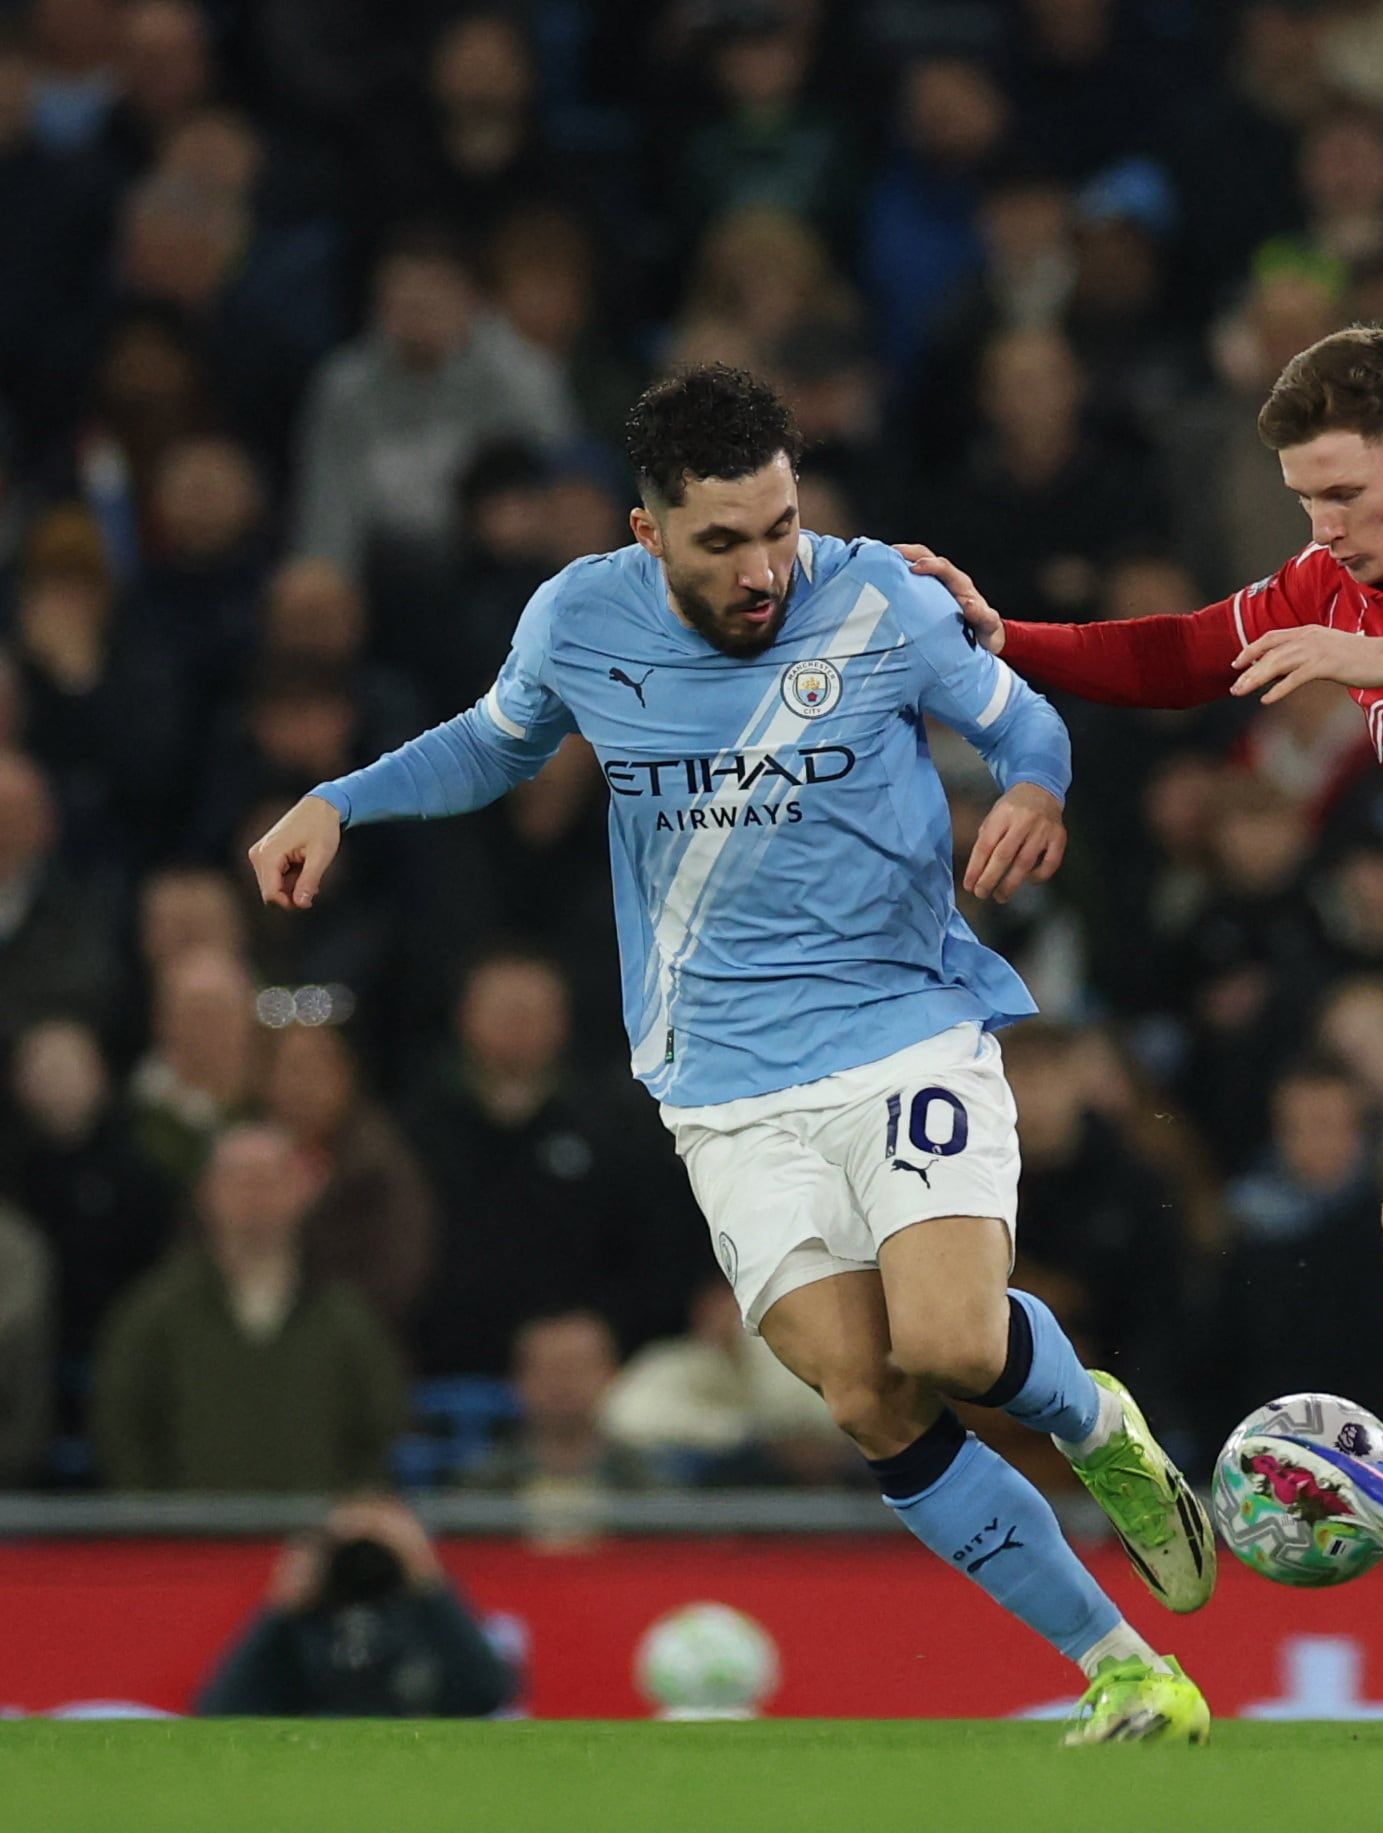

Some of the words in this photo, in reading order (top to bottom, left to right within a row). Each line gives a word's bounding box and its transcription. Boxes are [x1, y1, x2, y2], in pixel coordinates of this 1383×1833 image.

[787, 661, 837, 681] MANCHESTER
[803, 707, 822, 716] CITY
[604, 745, 855, 797] ETIHAD
[656, 801, 803, 832] AIRWAYS
[884, 1087, 968, 1159] 10
